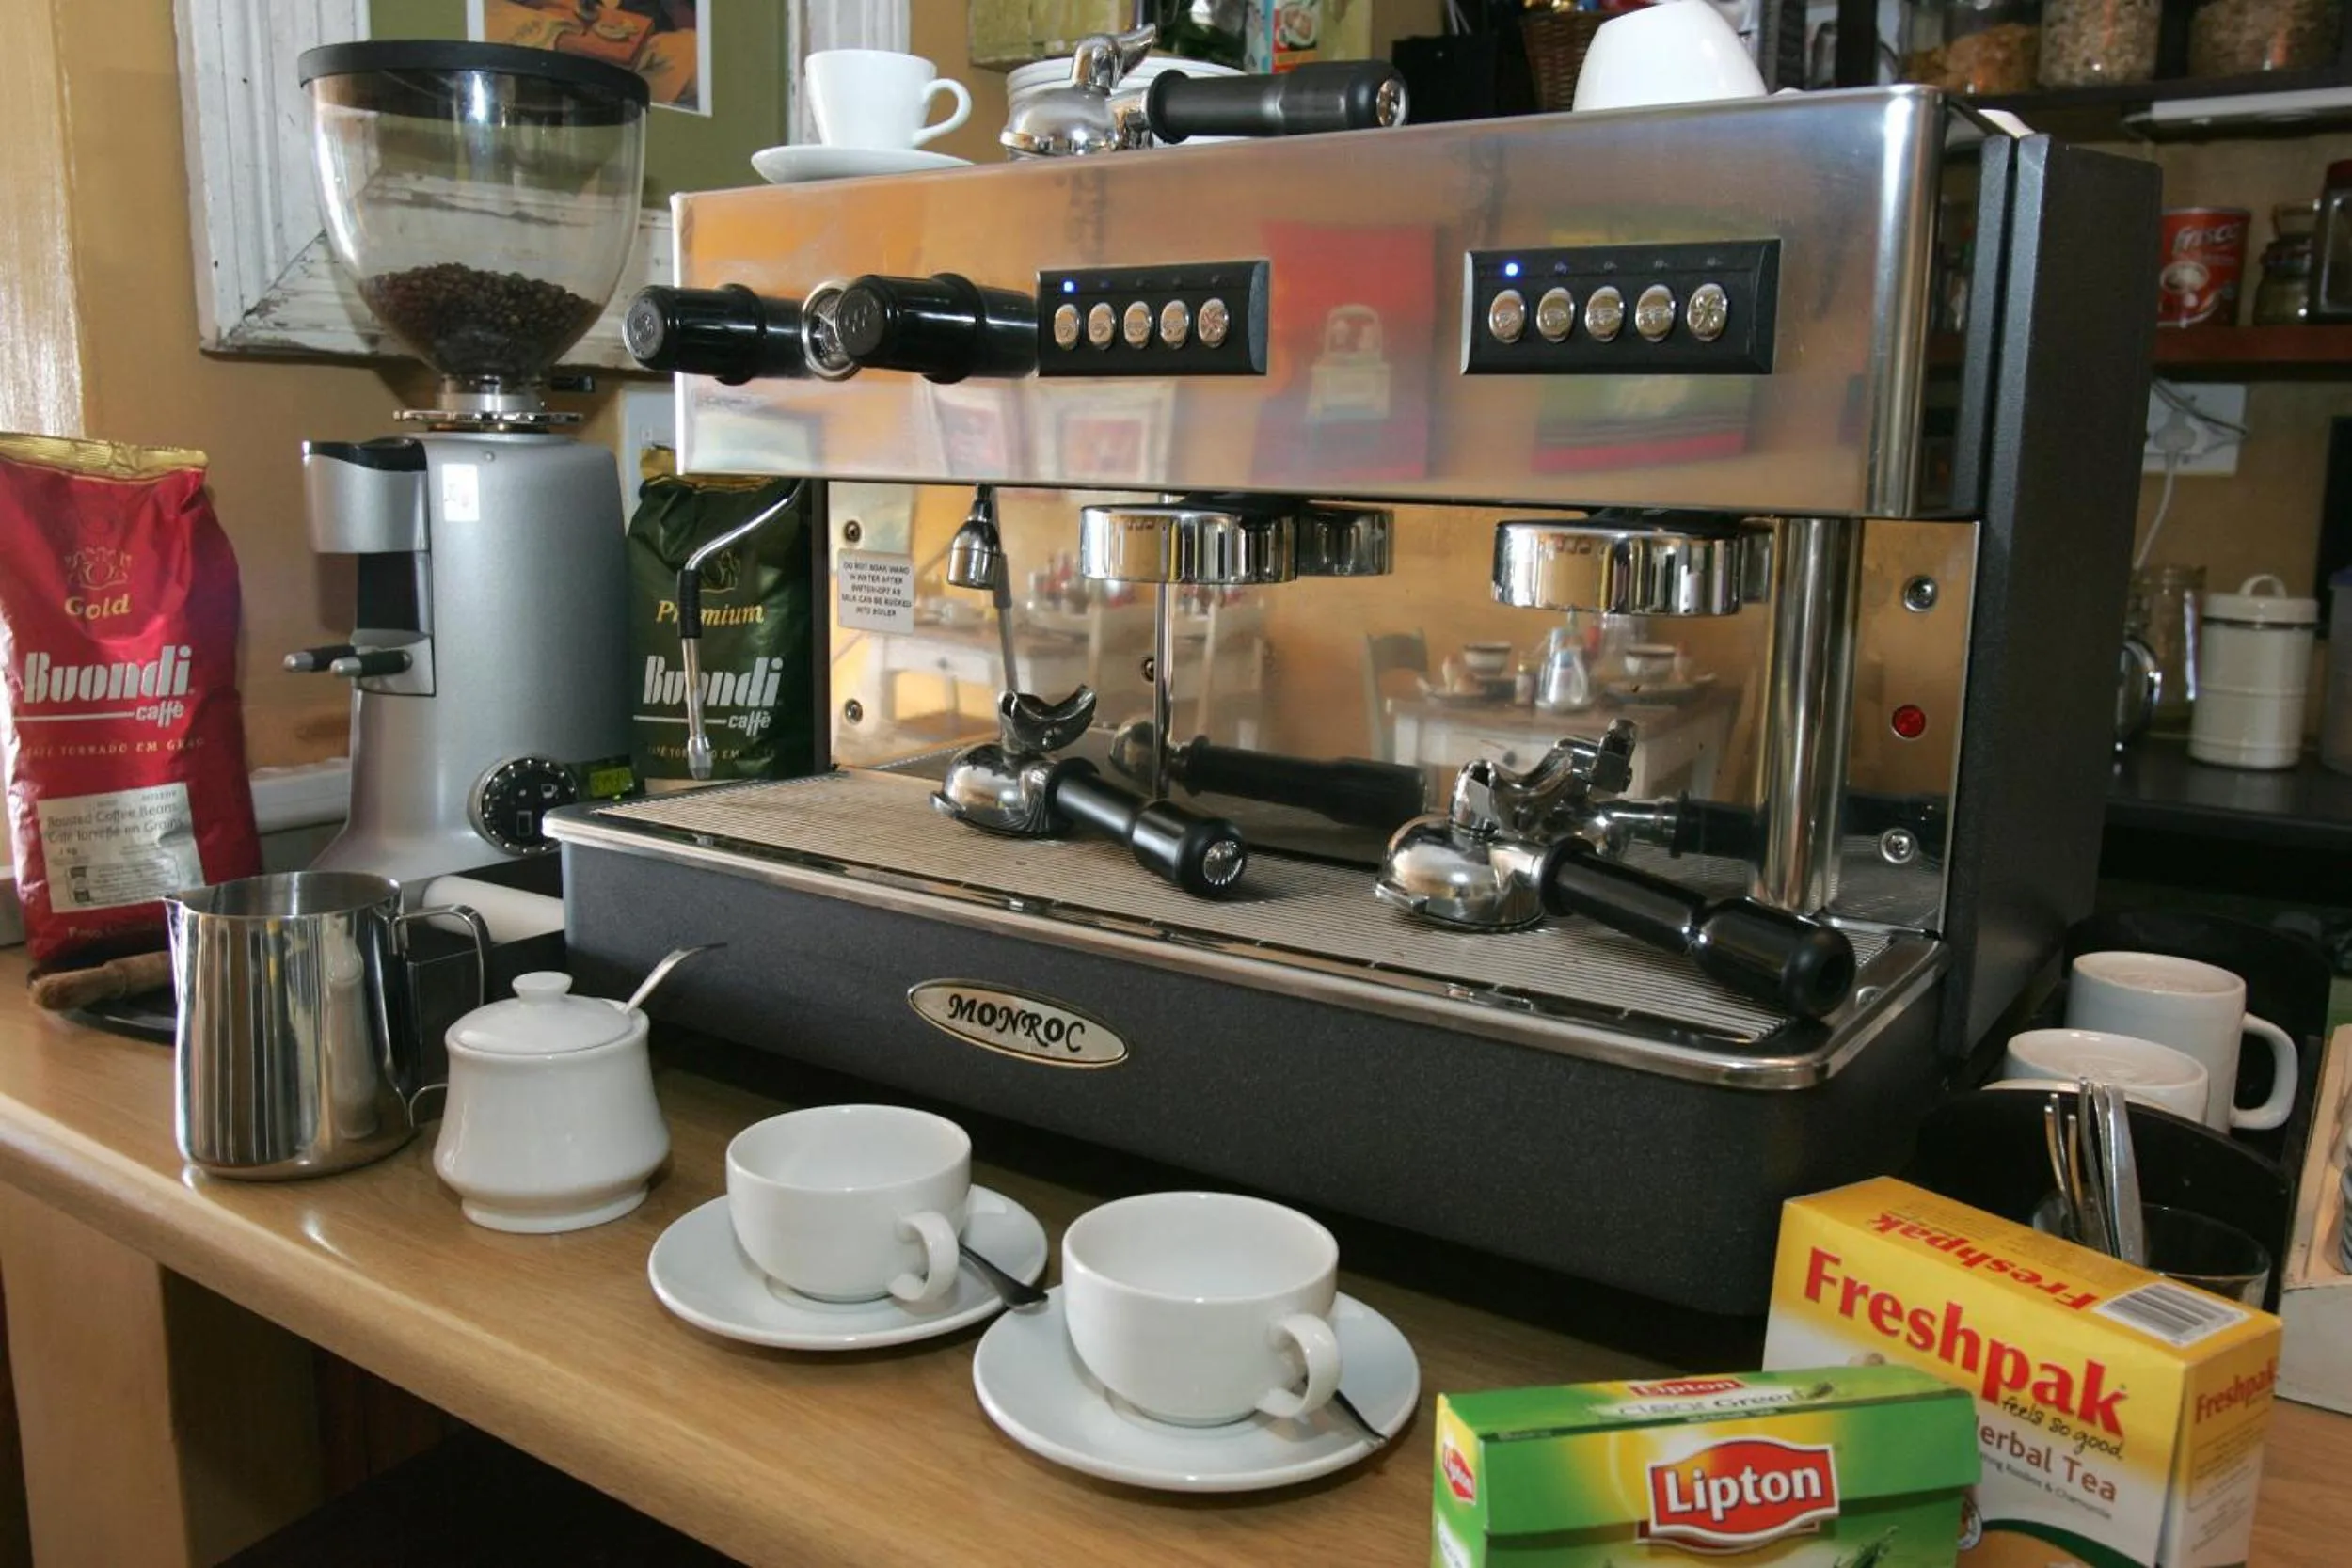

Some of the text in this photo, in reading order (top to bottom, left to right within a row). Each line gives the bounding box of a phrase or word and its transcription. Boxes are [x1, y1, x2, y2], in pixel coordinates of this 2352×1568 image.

[64, 594, 131, 620] Gold
[656, 600, 765, 626] Prmium
[24, 644, 193, 704] Buondi
[136, 740, 158, 752] EM
[96, 809, 135, 826] Coffee
[947, 993, 1085, 1053] MONROC
[1868, 1212, 2103, 1311] Freshpak
[1804, 1246, 2129, 1439] Freshpak
[1634, 1380, 1739, 1396] Lipton
[2002, 1396, 2045, 1426] feels
[2049, 1417, 2070, 1437] so
[1976, 1415, 2117, 1503] erbal Tea
[1664, 1467, 1822, 1521] Lipton
